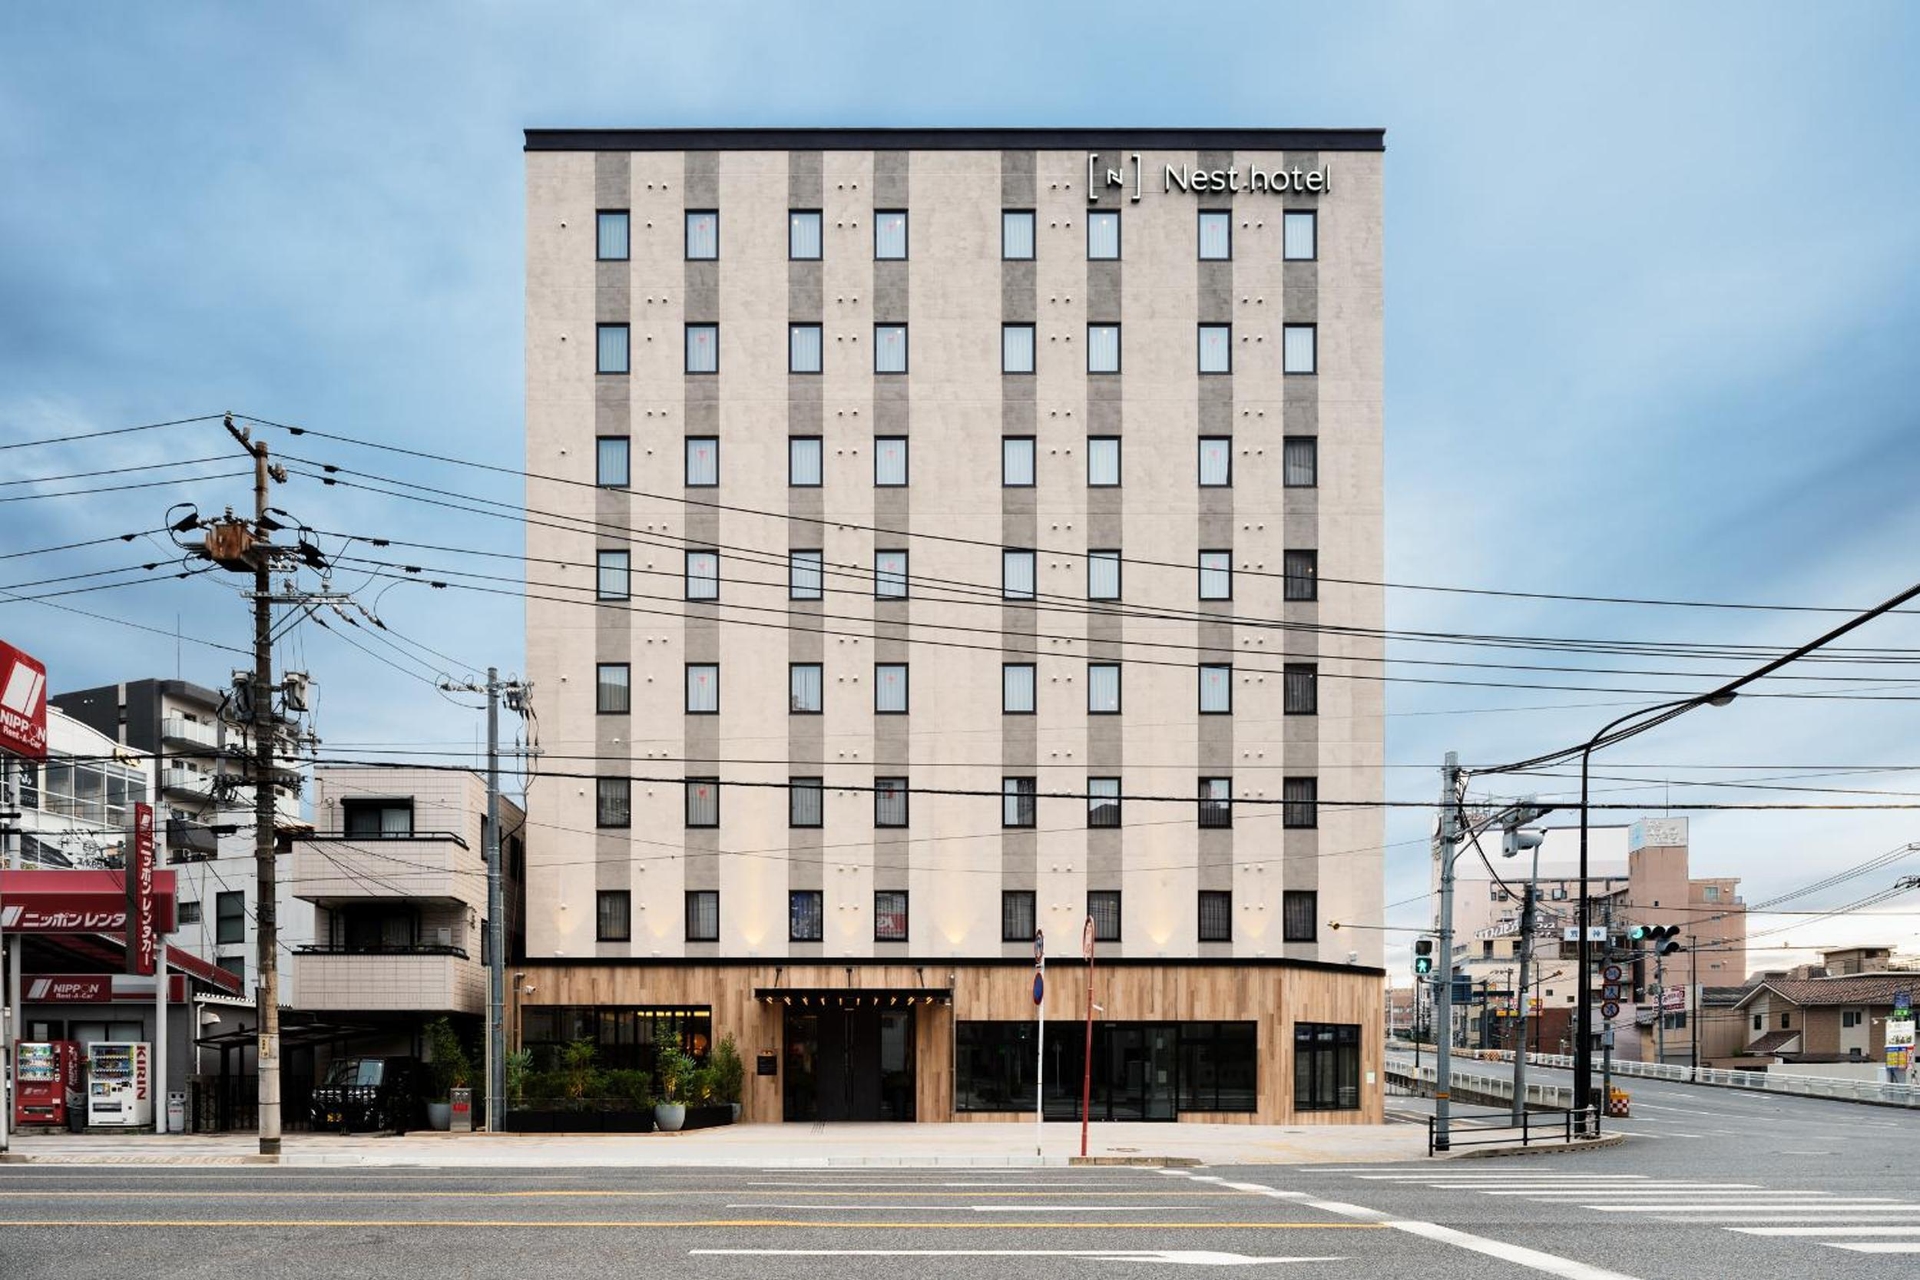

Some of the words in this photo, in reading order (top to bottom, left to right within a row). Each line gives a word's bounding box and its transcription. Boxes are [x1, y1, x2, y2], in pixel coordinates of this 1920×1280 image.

[1164, 163, 1239, 193] Nest
[1250, 163, 1332, 193] hotel
[0, 708, 46, 743] NIPPON
[22, 912, 126, 928] ニッポンレンタ
[53, 983, 99, 993] NIPPON
[136, 1045, 147, 1100] KIRIN
